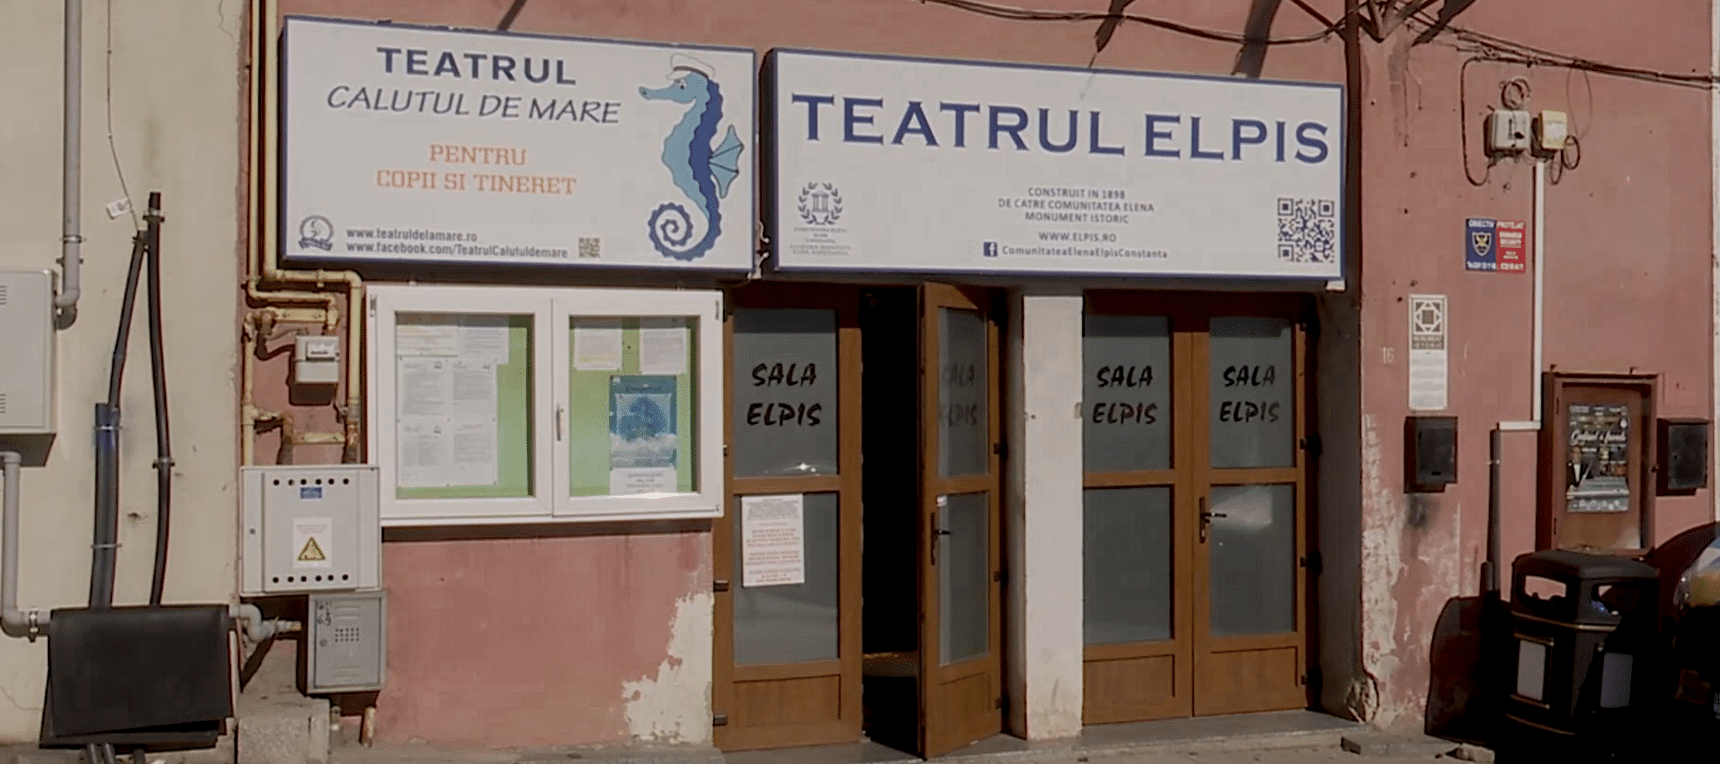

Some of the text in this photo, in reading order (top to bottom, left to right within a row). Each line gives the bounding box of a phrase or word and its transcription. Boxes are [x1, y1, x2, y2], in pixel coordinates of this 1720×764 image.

[376, 46, 576, 86] TEATRUL
[326, 85, 621, 124] CALUTUL DE MARE
[791, 93, 1330, 164] TEATRUL ELPIS
[428, 144, 528, 166] PENTRU
[376, 169, 577, 195] COPII SI TINERET
[1028, 187, 1126, 200] CONSTRUIT IN 1898
[998, 198, 1154, 213] DE CATRE COMUNITATEA ELENA
[1025, 211, 1130, 224] MONUMENT ISTORIC
[346, 227, 478, 243] www.teatruldelamare.ro
[1038, 231, 1117, 243] WWW.ELPIS.RO
[346, 241, 569, 259] www.facebook.com/TeatrulCalutuldemare
[1002, 245, 1168, 259] ComunitateaElenaElpisConstanta
[751, 362, 818, 387] SALA
[1096, 365, 1153, 388] SALA
[1222, 365, 1276, 387] SALA
[747, 402, 822, 427] ELPIS
[1092, 402, 1158, 425] ELPIS
[1219, 401, 1280, 423] ELPIS
